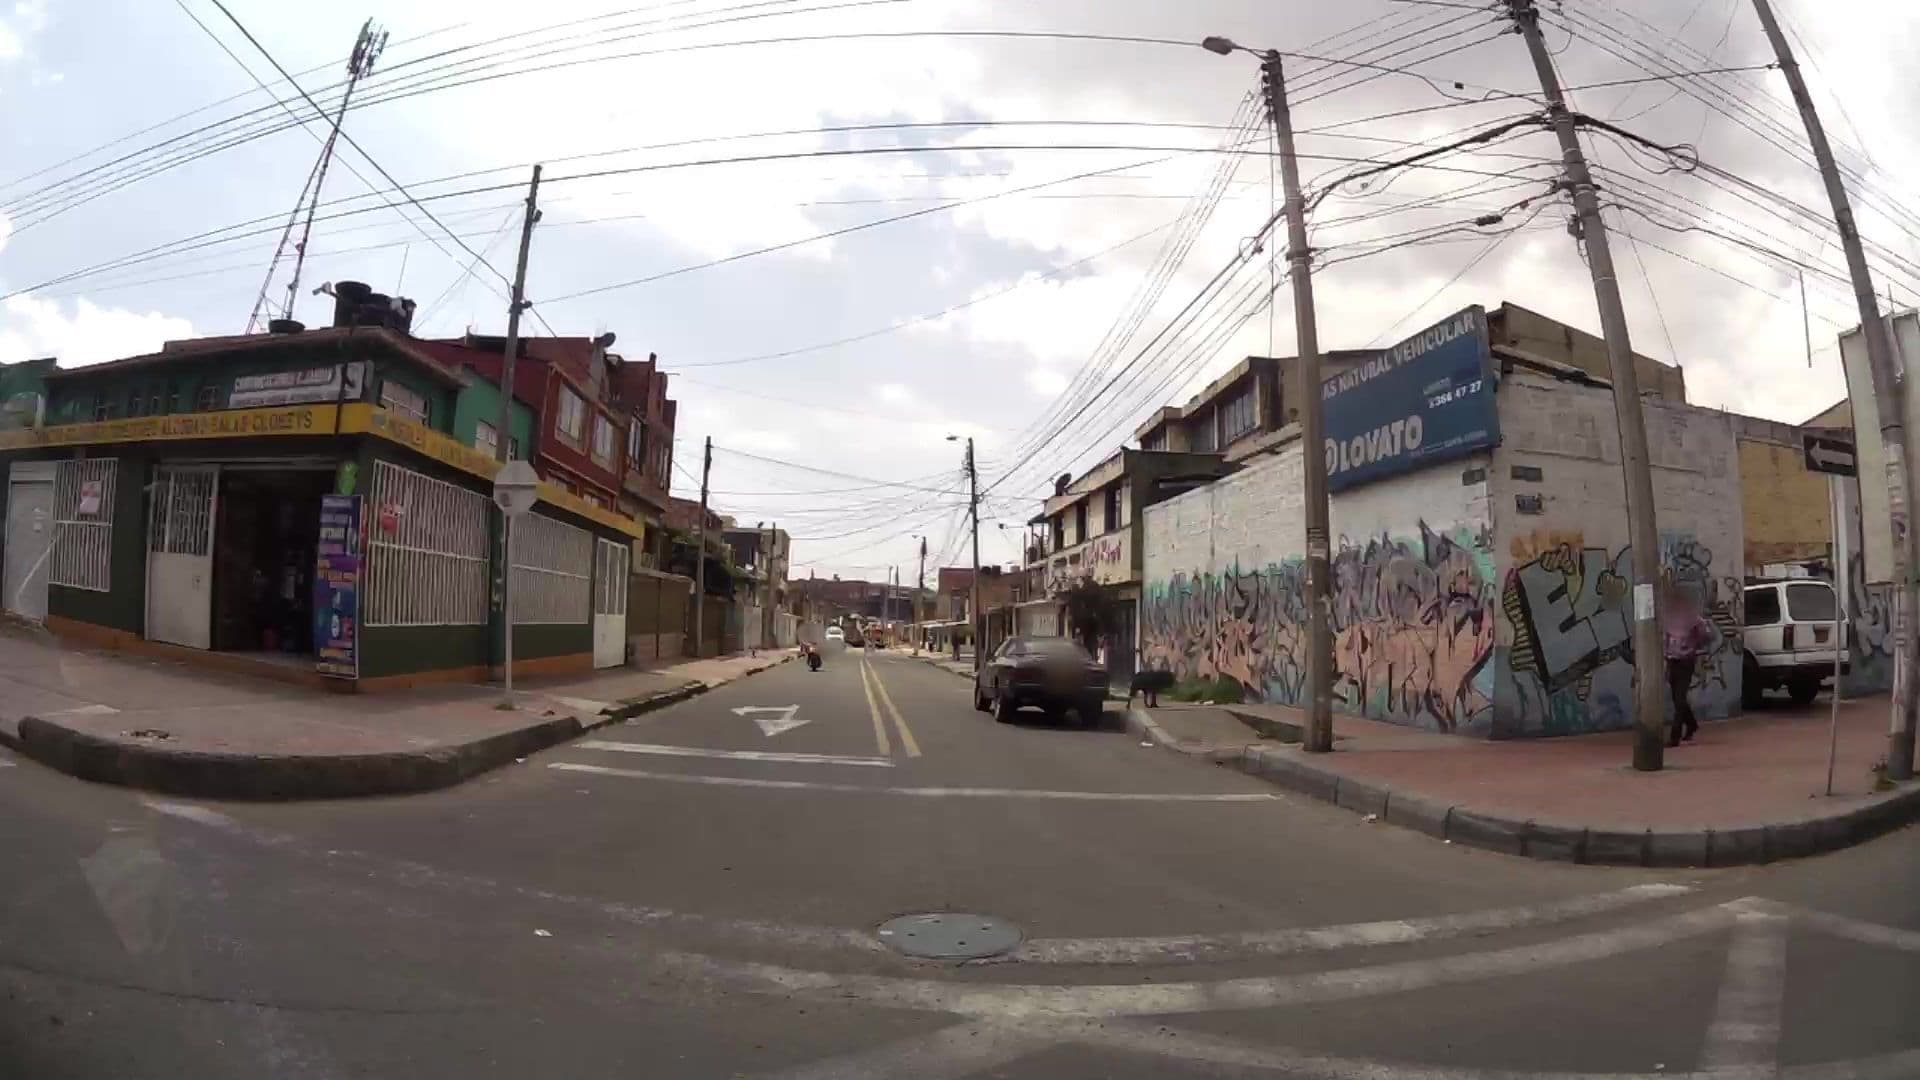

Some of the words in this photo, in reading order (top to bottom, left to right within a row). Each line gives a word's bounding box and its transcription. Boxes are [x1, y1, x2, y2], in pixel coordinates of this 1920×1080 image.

[1322, 380, 1337, 400] AS
[1338, 354, 1392, 393] NATURAL
[1394, 313, 1475, 364] VEHICULAR
[1339, 415, 1423, 471] LOVATO
